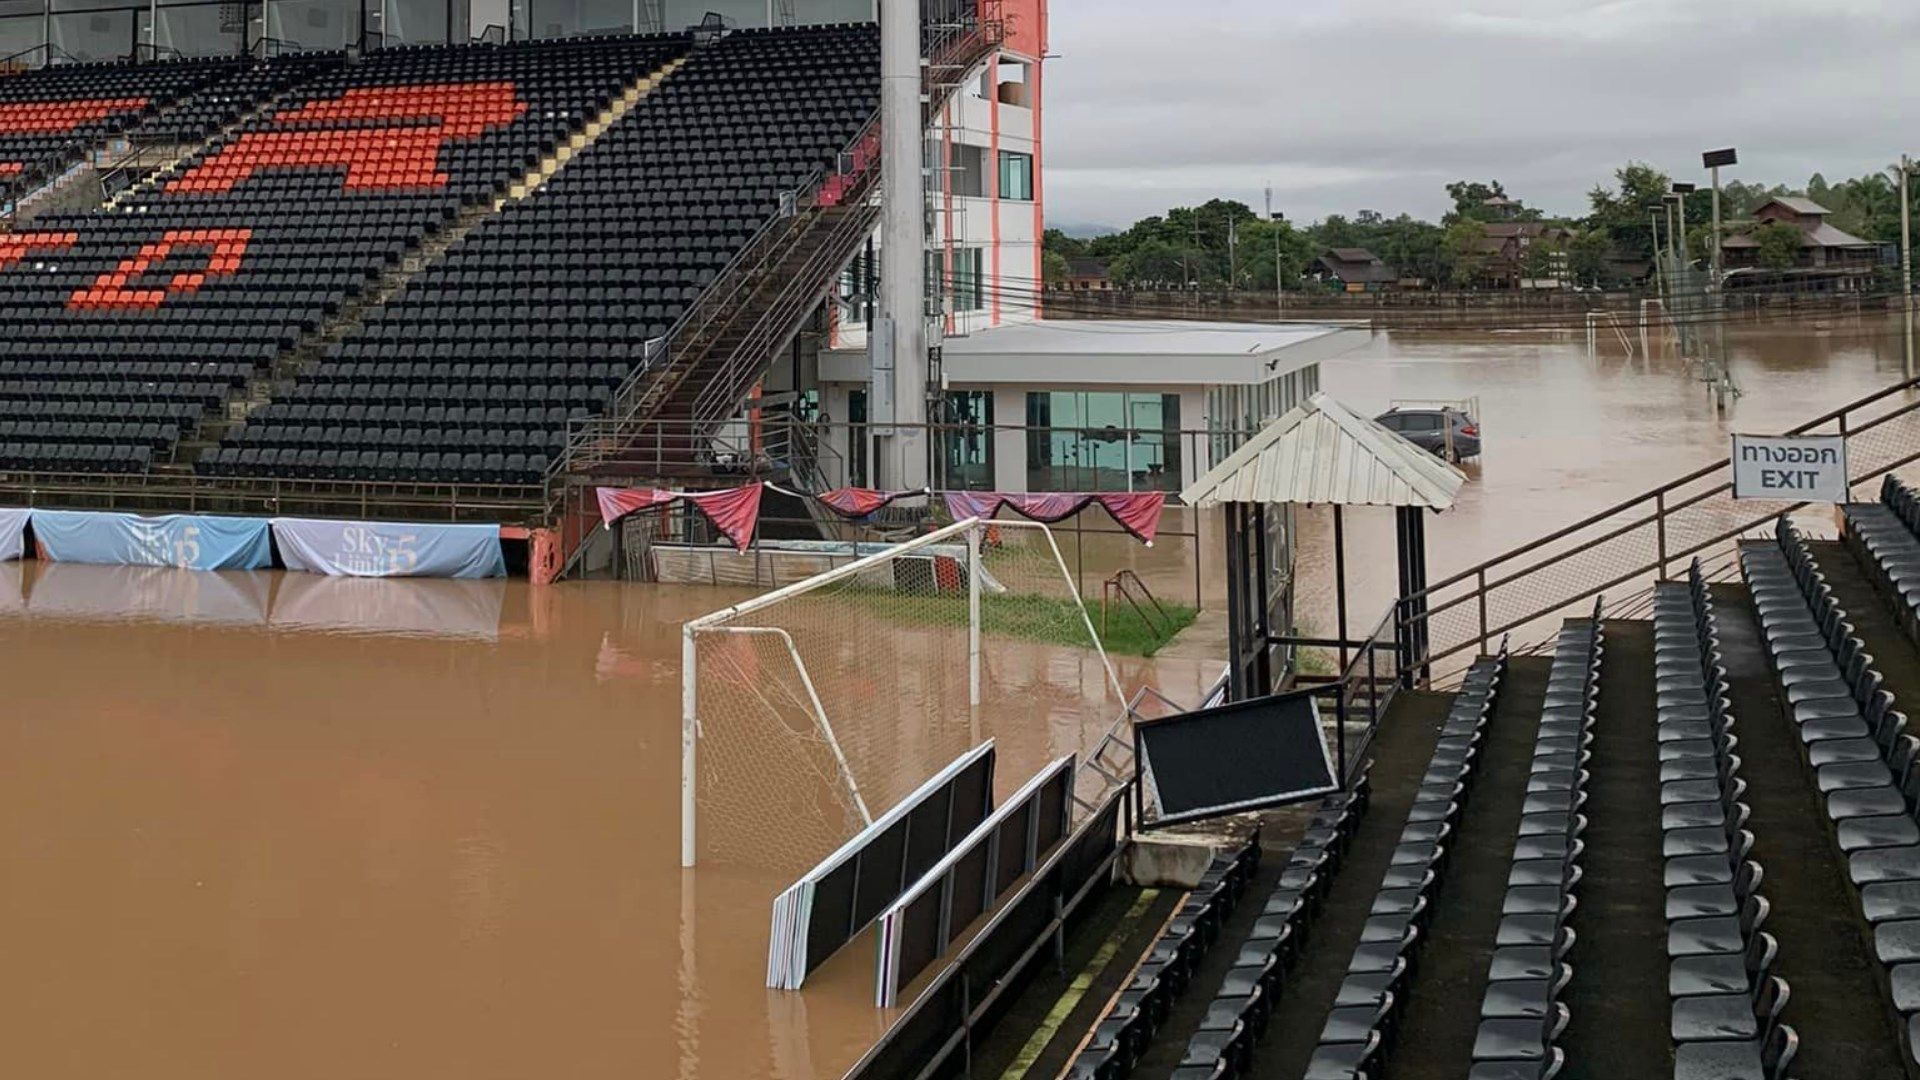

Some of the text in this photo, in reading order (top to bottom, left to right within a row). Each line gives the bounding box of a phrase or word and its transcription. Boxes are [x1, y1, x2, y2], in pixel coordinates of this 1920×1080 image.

[1742, 445, 1837, 464] ทางออก
[1761, 469, 1820, 489] EXIT
[343, 526, 389, 555] Sky
